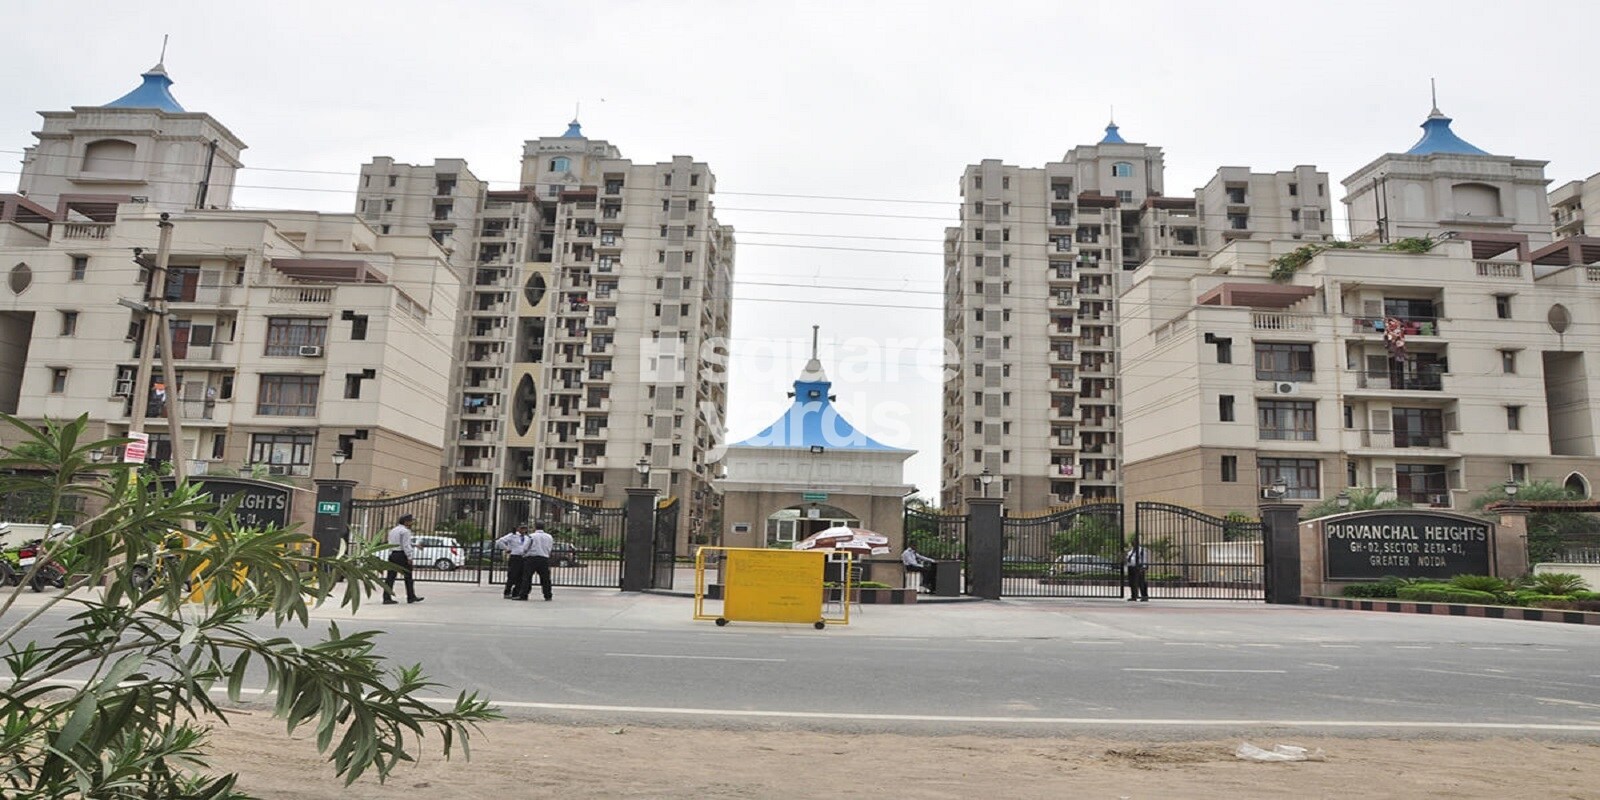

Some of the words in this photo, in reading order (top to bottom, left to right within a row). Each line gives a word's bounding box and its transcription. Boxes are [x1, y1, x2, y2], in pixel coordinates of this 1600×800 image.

[220, 493, 285, 509] HIGHTS
[1327, 524, 1419, 540] PURVANCHAL
[1424, 526, 1486, 542] HEIGHTS
[1369, 555, 1411, 567] GREATER
[1417, 556, 1447, 567] NOIDA
